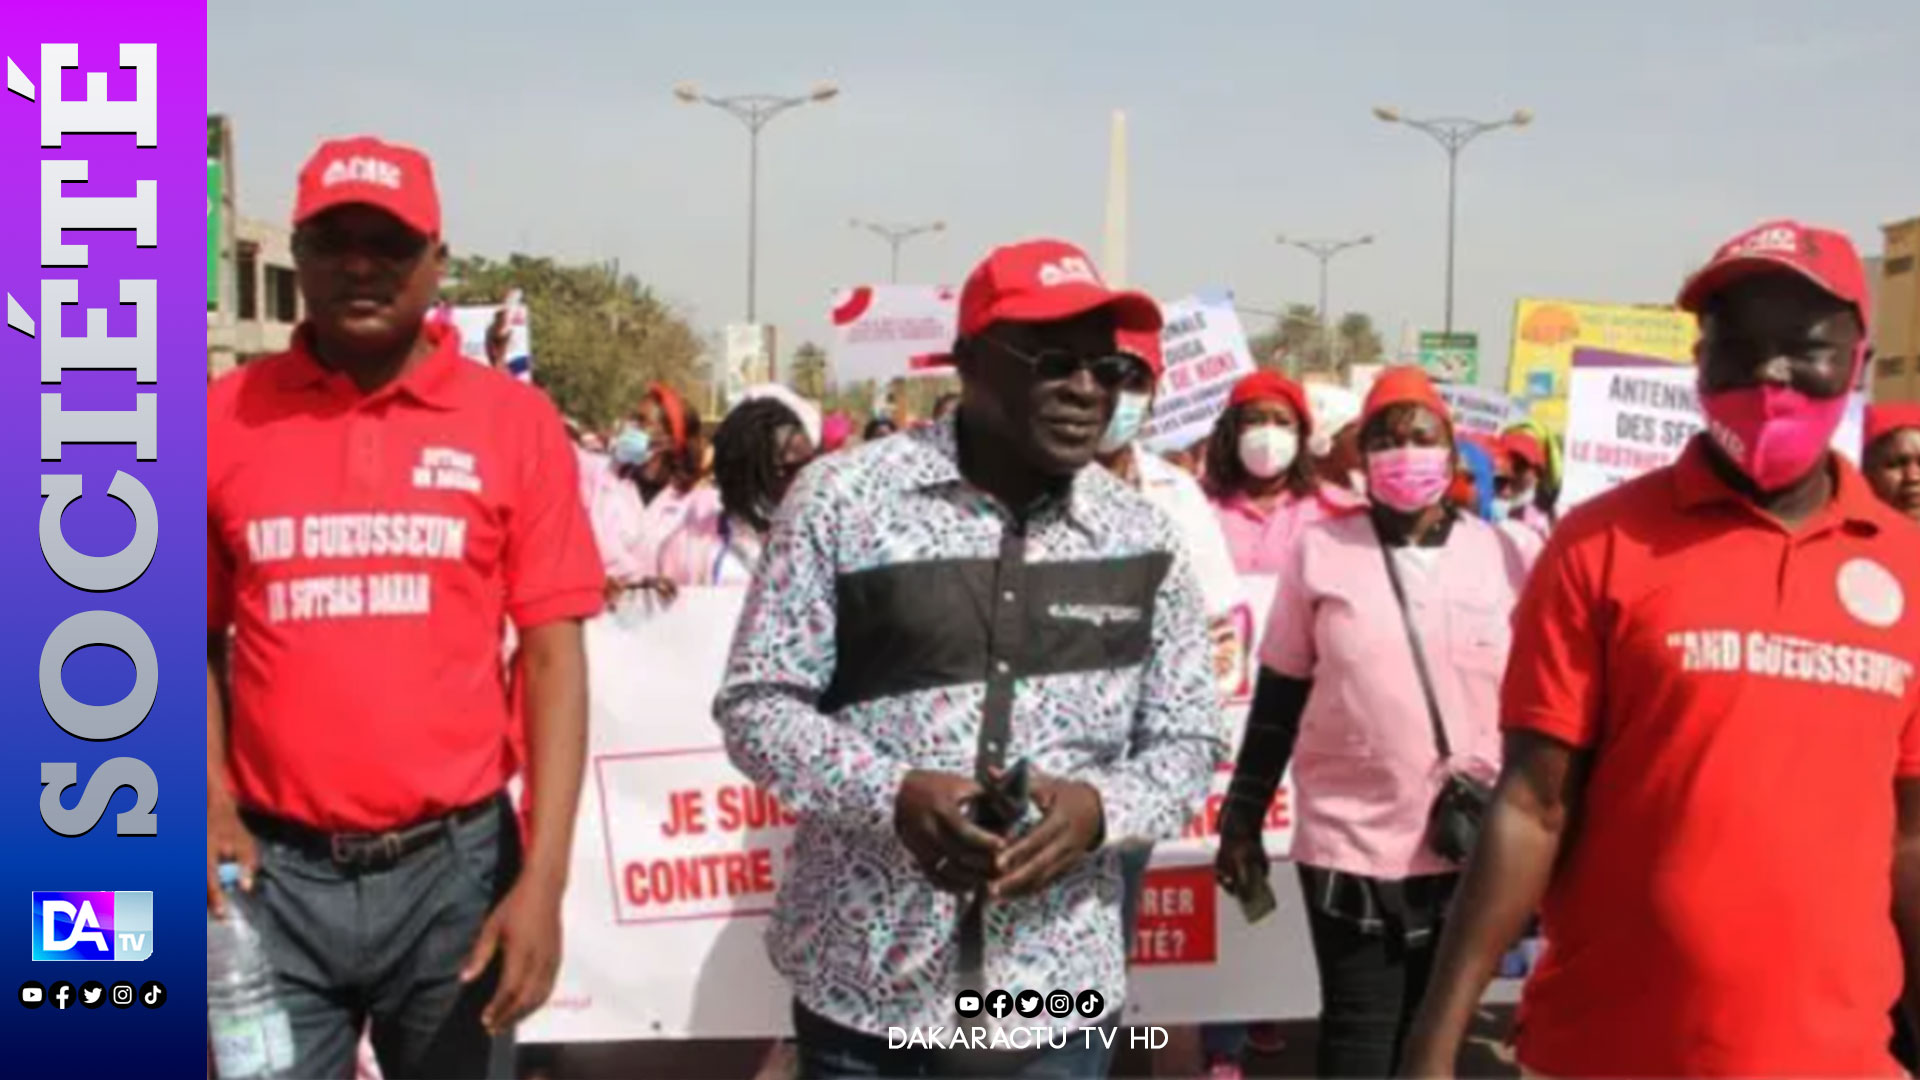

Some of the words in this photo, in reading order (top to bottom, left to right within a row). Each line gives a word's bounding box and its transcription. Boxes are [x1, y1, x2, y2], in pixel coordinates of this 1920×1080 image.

[1616, 410, 1656, 443] DES
[660, 790, 706, 838] JE
[624, 847, 774, 907] CONTRE
